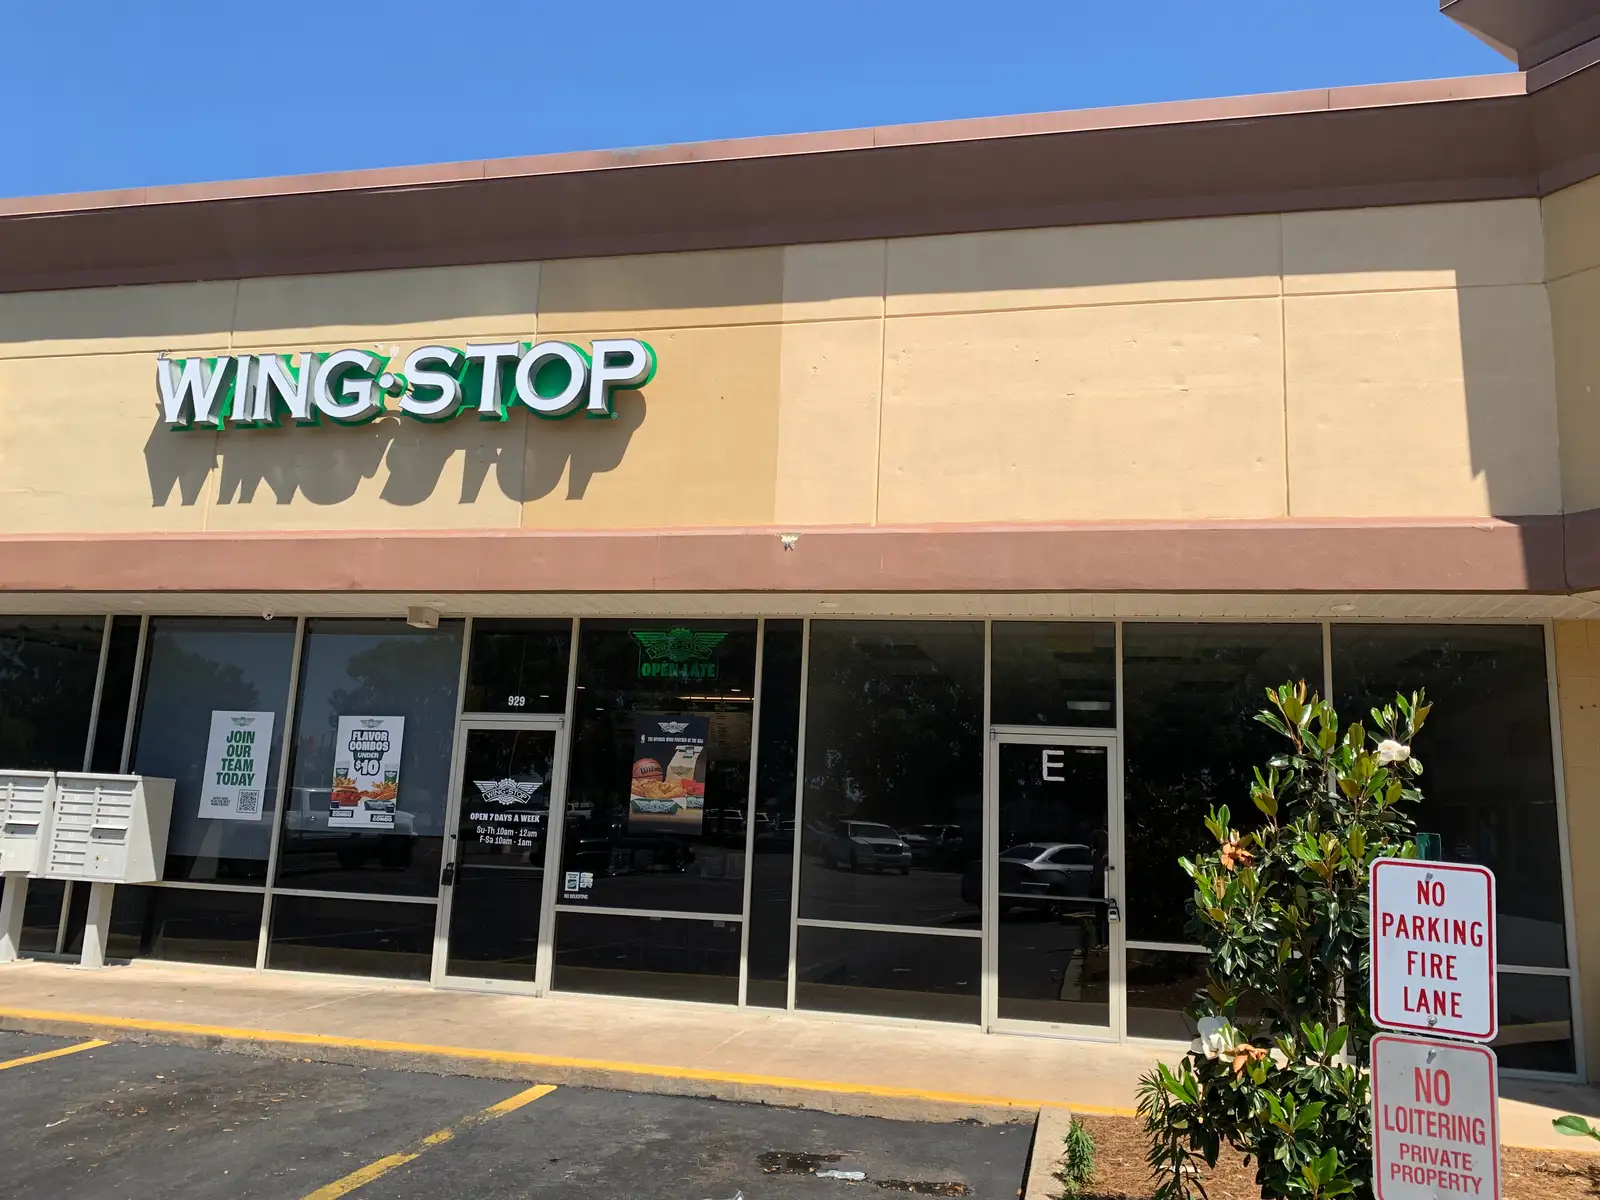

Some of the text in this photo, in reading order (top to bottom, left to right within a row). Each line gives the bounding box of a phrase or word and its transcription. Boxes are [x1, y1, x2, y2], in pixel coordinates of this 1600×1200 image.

[641, 662, 716, 678] OPEN LATE
[508, 695, 526, 707] 929
[226, 730, 256, 744] JOIN
[352, 731, 388, 741] FLAVOR
[226, 744, 252, 758] OUR
[349, 741, 390, 751] COMBOS
[221, 758, 254, 772] TEAM
[355, 759, 380, 775] $10
[1042, 750, 1065, 781] E
[216, 772, 256, 786] TODAY
[470, 812, 540, 823] OPEN 7 DAYS A WEEK
[476, 825, 495, 835] Su-Th
[496, 827, 514, 836] 10am
[519, 828, 538, 838] 12am
[480, 835, 494, 844] F-Sa
[494, 836, 512, 845] 10am
[517, 838, 532, 847] 1am
[1417, 880, 1446, 907] NO
[1382, 912, 1483, 948] PARKING
[1407, 950, 1458, 981] FIRE
[1404, 986, 1463, 1018] LANE
[1414, 1066, 1451, 1107] NO
[1384, 1104, 1486, 1146] LOITERING
[1400, 1142, 1473, 1172] PRIVATE
[1390, 1162, 1483, 1195] PROPERTY
